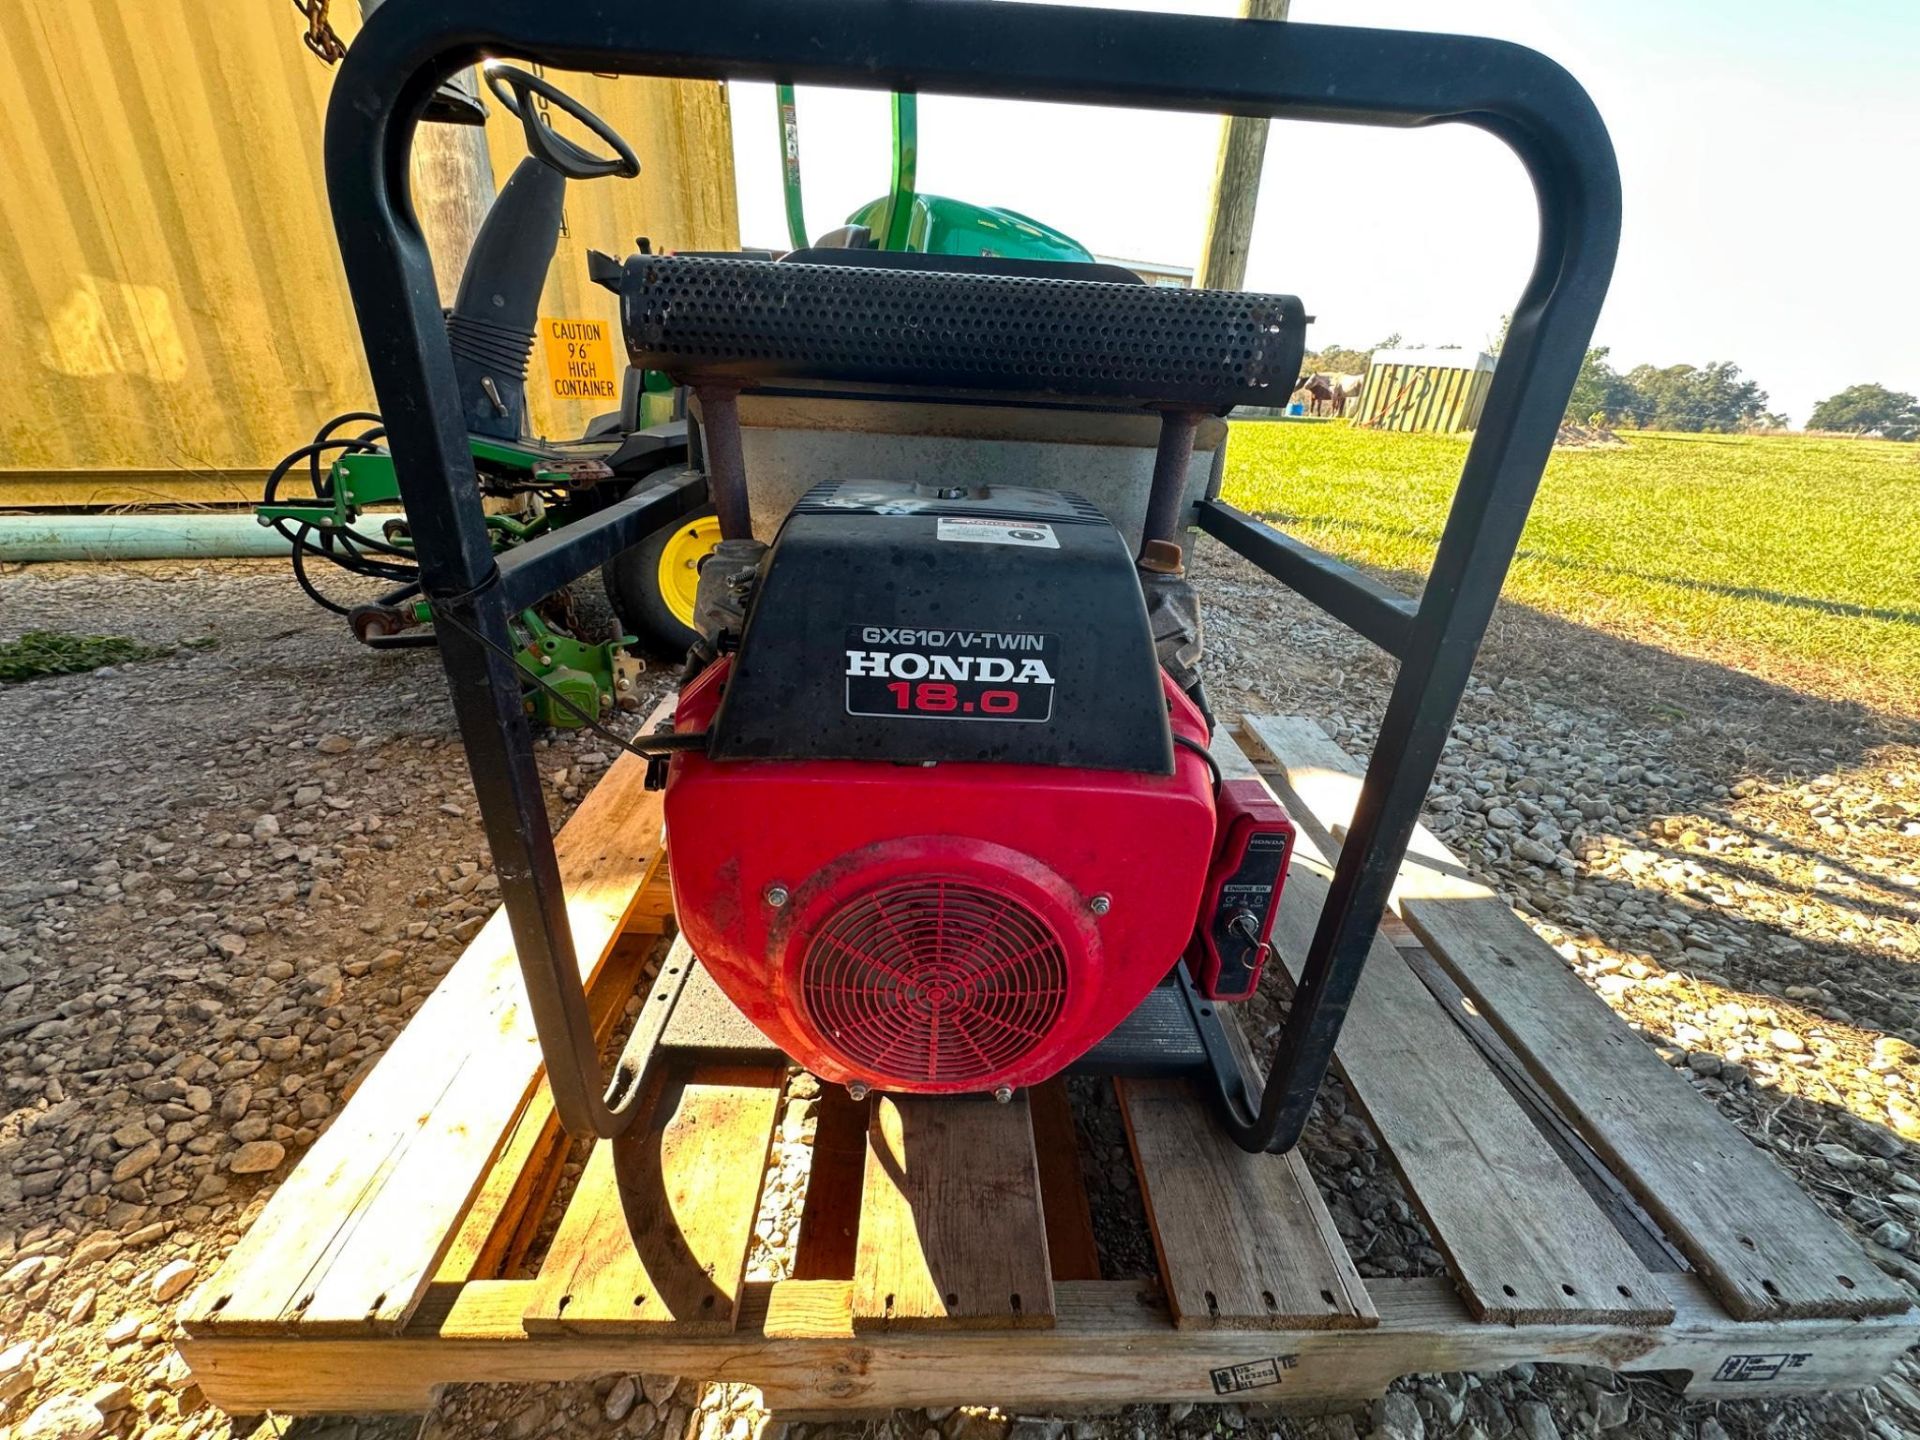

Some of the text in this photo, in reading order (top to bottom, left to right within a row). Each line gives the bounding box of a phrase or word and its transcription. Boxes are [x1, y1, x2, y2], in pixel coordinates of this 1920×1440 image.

[552, 322, 601, 341] CAUTION
[568, 361, 597, 378] HIGH
[554, 379, 615, 397] CONTAINER
[862, 626, 1044, 651] GX610/V-TWIN
[845, 649, 1056, 684] HONDA
[886, 681, 1019, 714] 18.0
